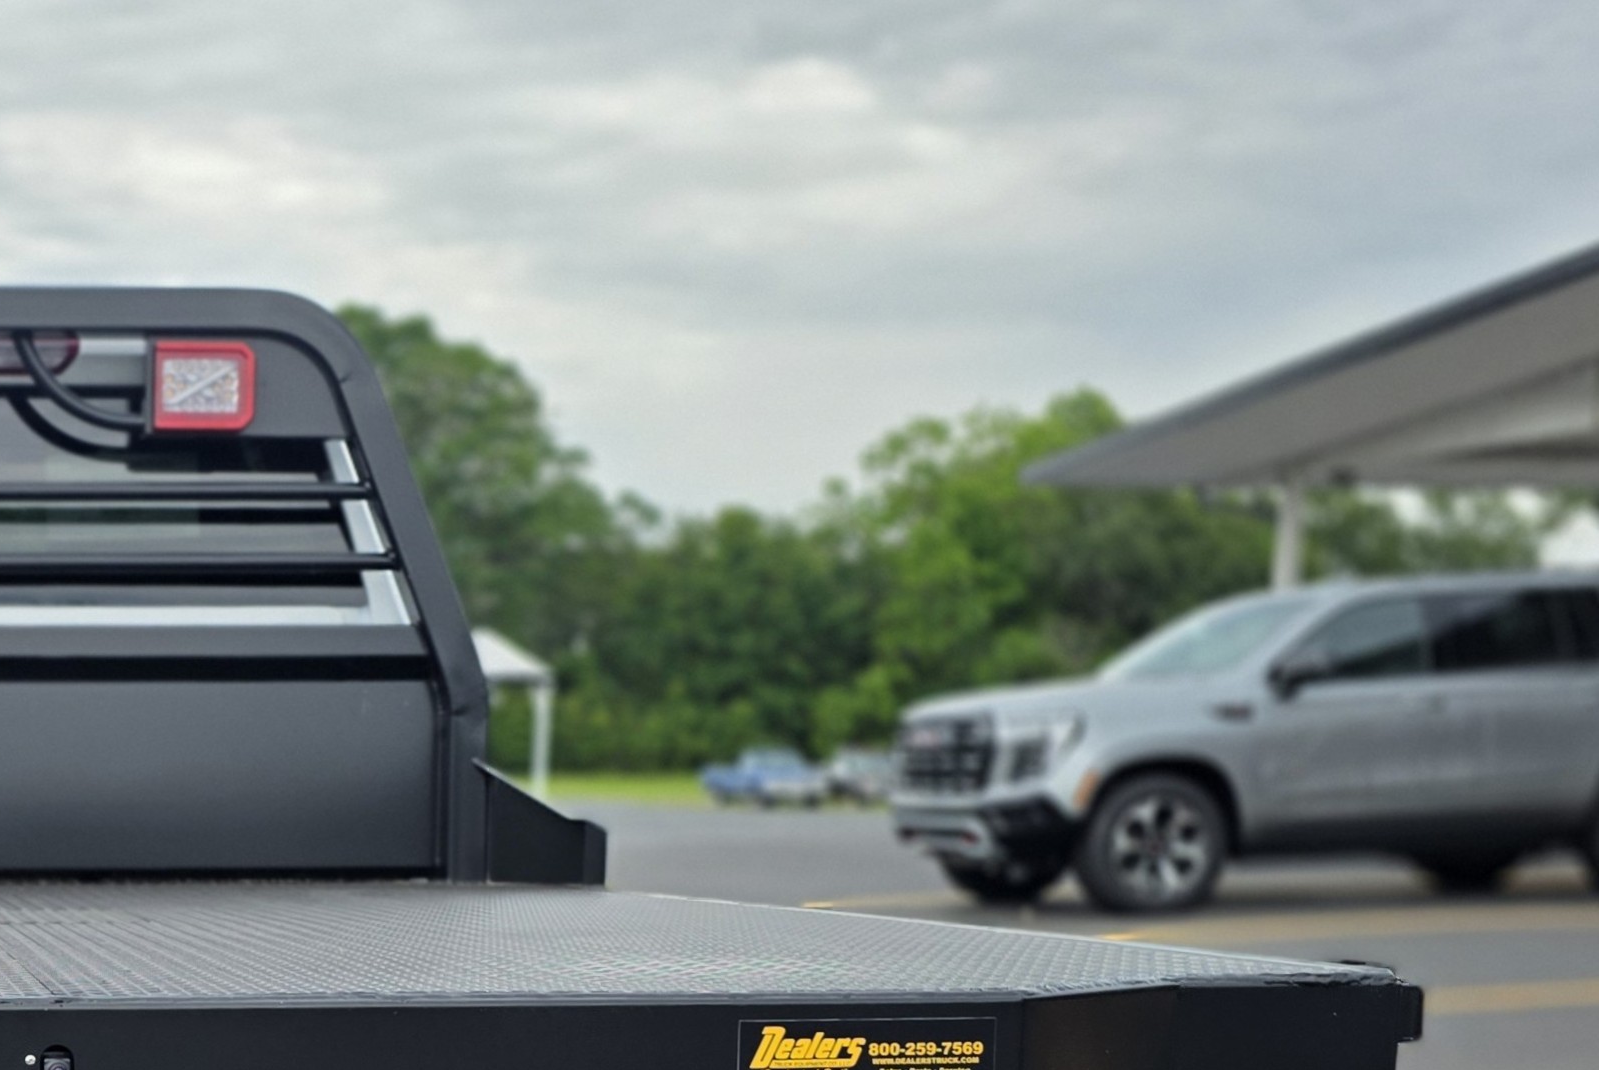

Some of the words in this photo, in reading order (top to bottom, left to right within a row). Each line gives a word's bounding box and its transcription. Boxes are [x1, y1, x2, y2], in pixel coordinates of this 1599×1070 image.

[749, 1026, 866, 1069] Dealers
[868, 1041, 984, 1056] 800-259-7569
[872, 1057, 980, 1065] WWW.DEALERSTRUCK.COM
